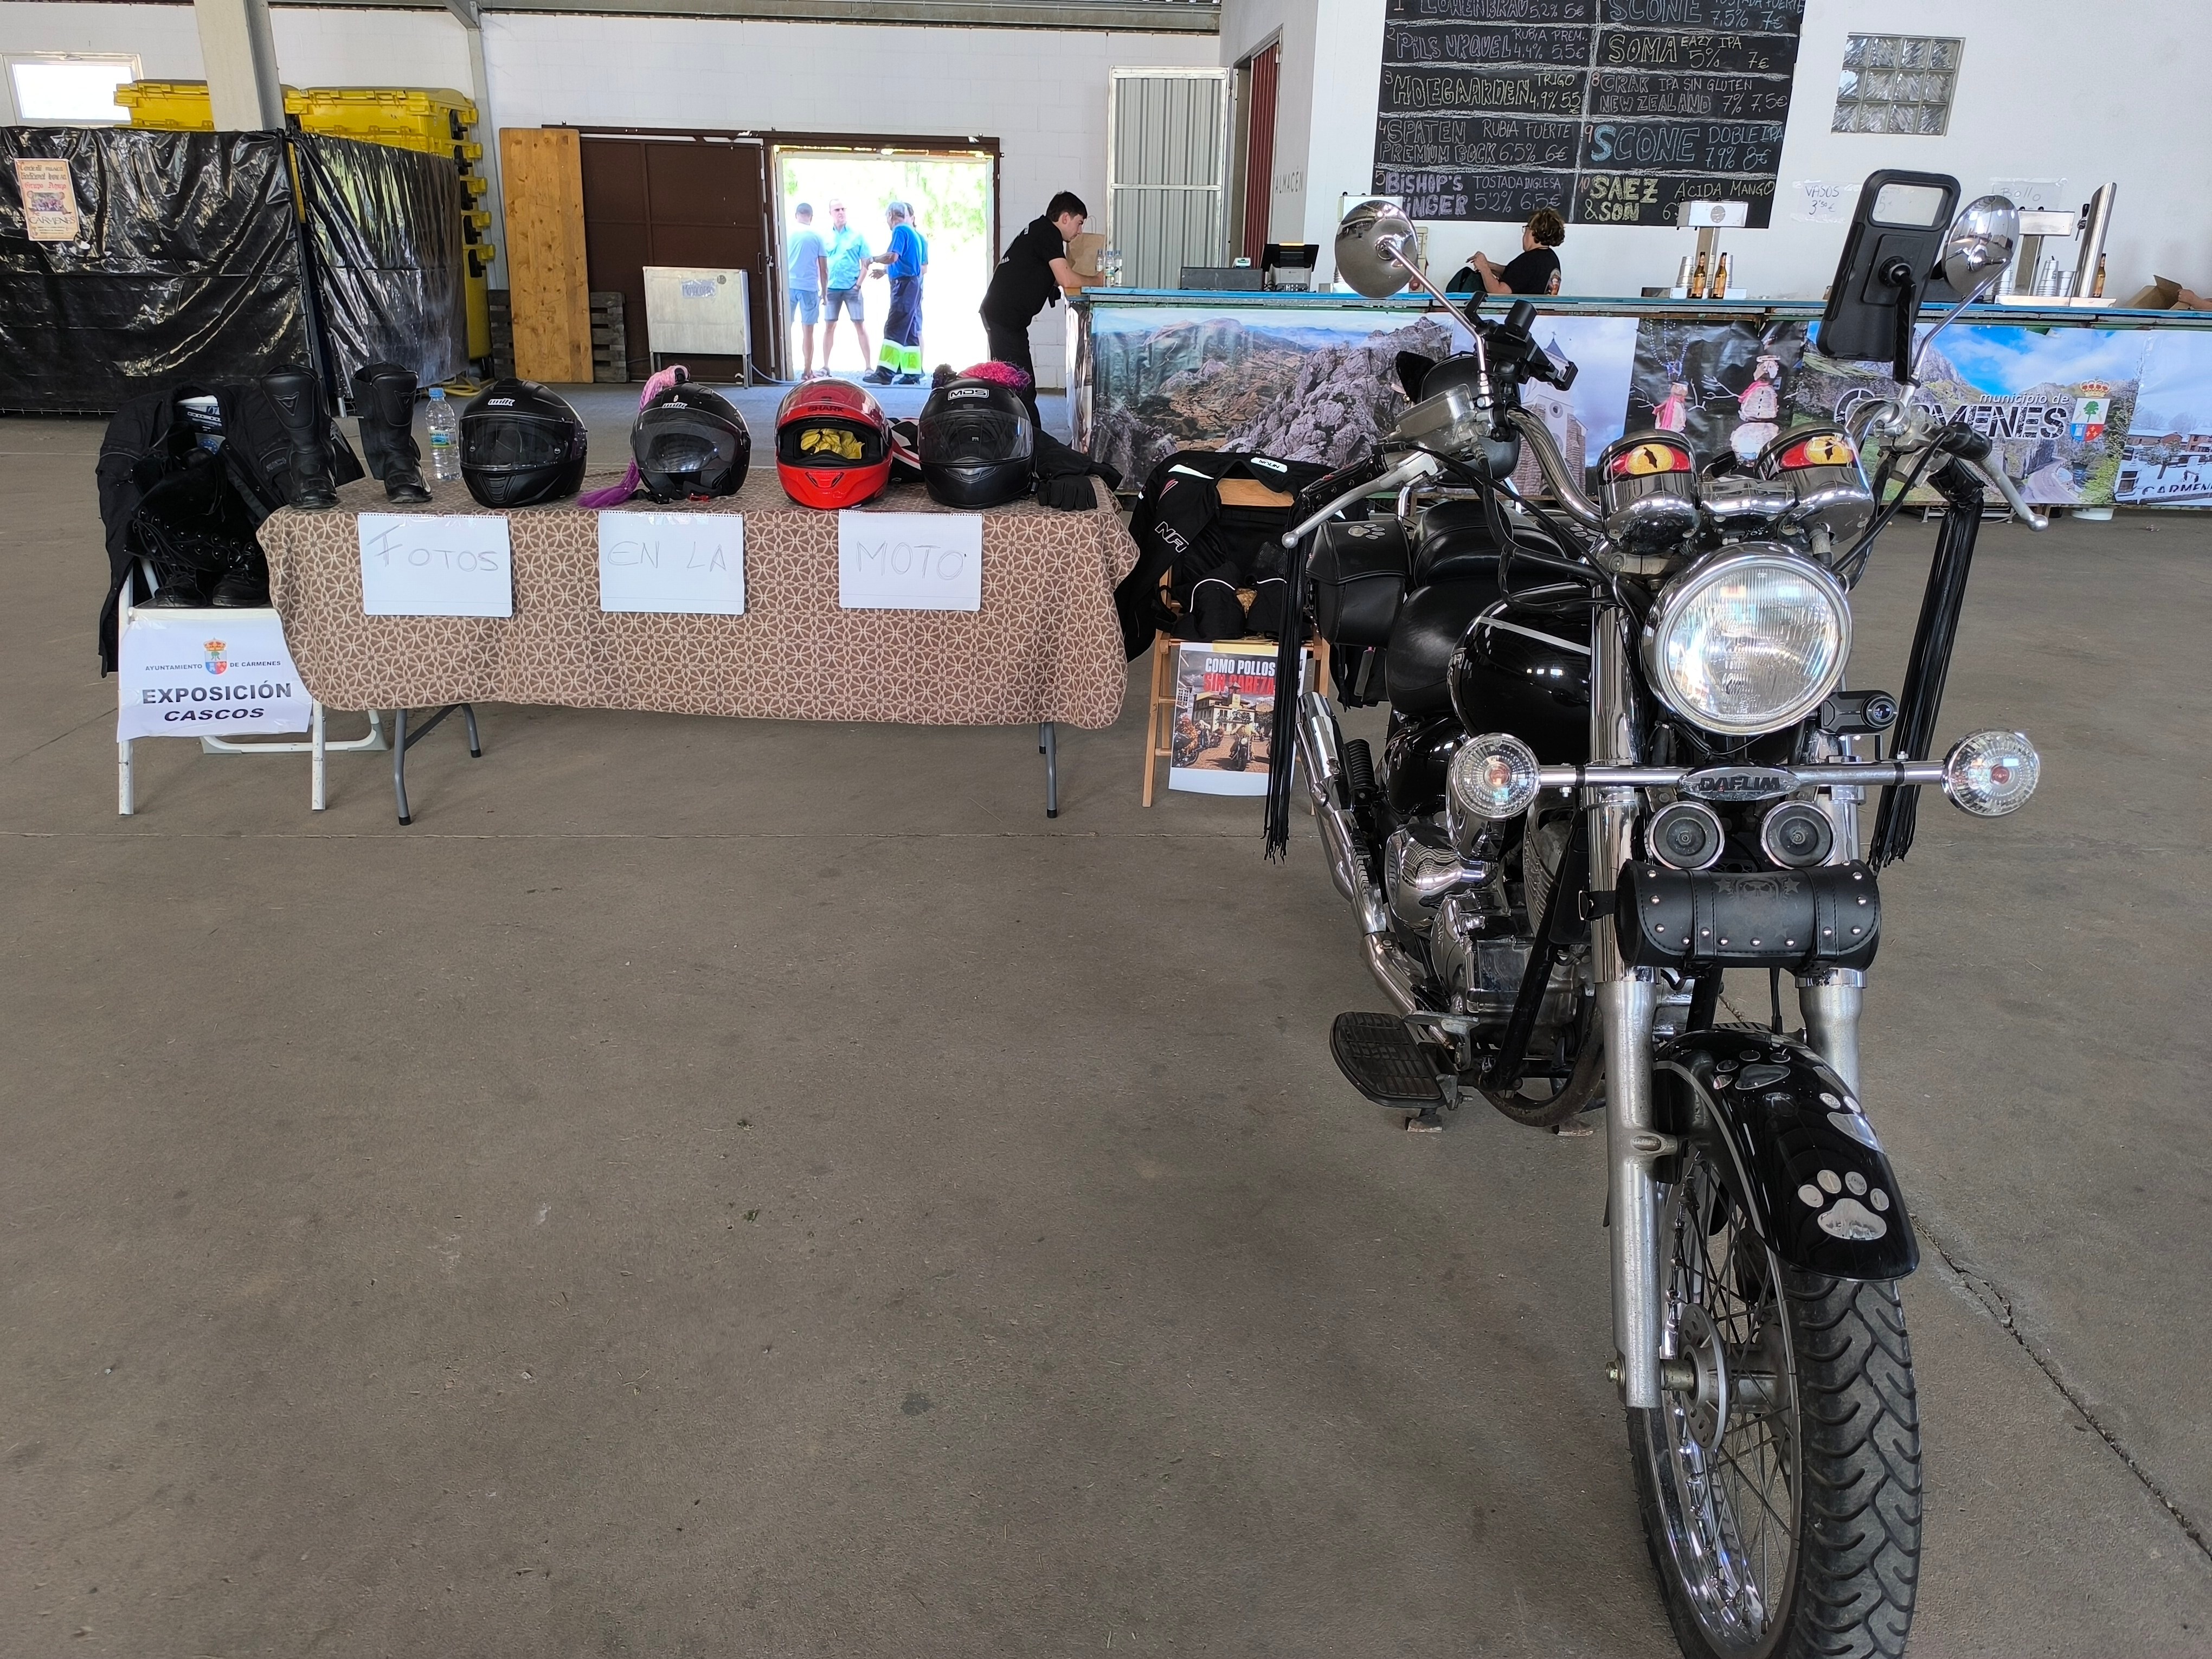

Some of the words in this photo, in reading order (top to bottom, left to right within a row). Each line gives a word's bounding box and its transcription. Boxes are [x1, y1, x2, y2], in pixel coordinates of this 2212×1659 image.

[1609, 0, 1702, 22] SCONE
[1711, 10, 1748, 28] 7,5%
[1761, 11, 1784, 30] 7€
[1387, 28, 1396, 40] 2
[1514, 43, 1542, 59] 4,4%
[1552, 44, 1585, 60] 5,5€
[1609, 34, 1677, 63] SOMA
[1681, 36, 1712, 48] EAZY
[1719, 38, 1742, 49] IPA
[1689, 48, 1720, 68] 5%
[1748, 52, 1769, 69] 7€
[1385, 71, 1393, 84] 3
[1534, 73, 1575, 87] TRIGO
[1591, 73, 1600, 87] 8
[1600, 75, 1650, 93] CRAK
[1659, 79, 1679, 90] IPA
[1683, 79, 1702, 91] SIN
[1707, 79, 1752, 91] GLUTEN
[1600, 95, 1635, 113] NEW
[1637, 94, 1712, 113] ZEALAND
[1722, 94, 1747, 113] 7%
[1378, 120, 1386, 134] 4
[1387, 119, 1465, 144] SPATEN
[1524, 122, 1571, 138] FUERTE
[1455, 143, 1497, 163] BOCK
[1499, 143, 1535, 162] 6,5%
[1545, 145, 1568, 162] 6€
[1585, 125, 1592, 143] 9
[1591, 125, 1700, 162] SCONE
[1708, 126, 1758, 144] DOBLE
[1761, 126, 1784, 143] IPA
[1743, 146, 1771, 171] 8€
[1375, 170, 1385, 186] 5
[1472, 176, 1523, 189] TOSTADA
[1523, 178, 1562, 189] INGLESA
[1578, 177, 1590, 192] 10
[1590, 175, 1658, 203] SAEZ
[1729, 181, 1776, 196] MANGO
[1520, 192, 1562, 211] 6,5€
[1805, 186, 1840, 197] VASOS
[950, 390, 986, 398] MDS
[1979, 392, 2048, 406] municipio
[2052, 393, 2070, 405] de
[367, 524, 499, 573] FOTOS
[607, 541, 660, 569] EN
[686, 544, 727, 571] LA
[856, 541, 967, 581] MOTO
[145, 663, 203, 671] AYUNTAMIENTO
[1205, 658, 1235, 674] COMO
[1237, 660, 1276, 677] POLLOS
[142, 680, 292, 705] EXPOSICIÓN
[1203, 673, 1226, 692] SIN
[164, 707, 265, 722] CASCOS
